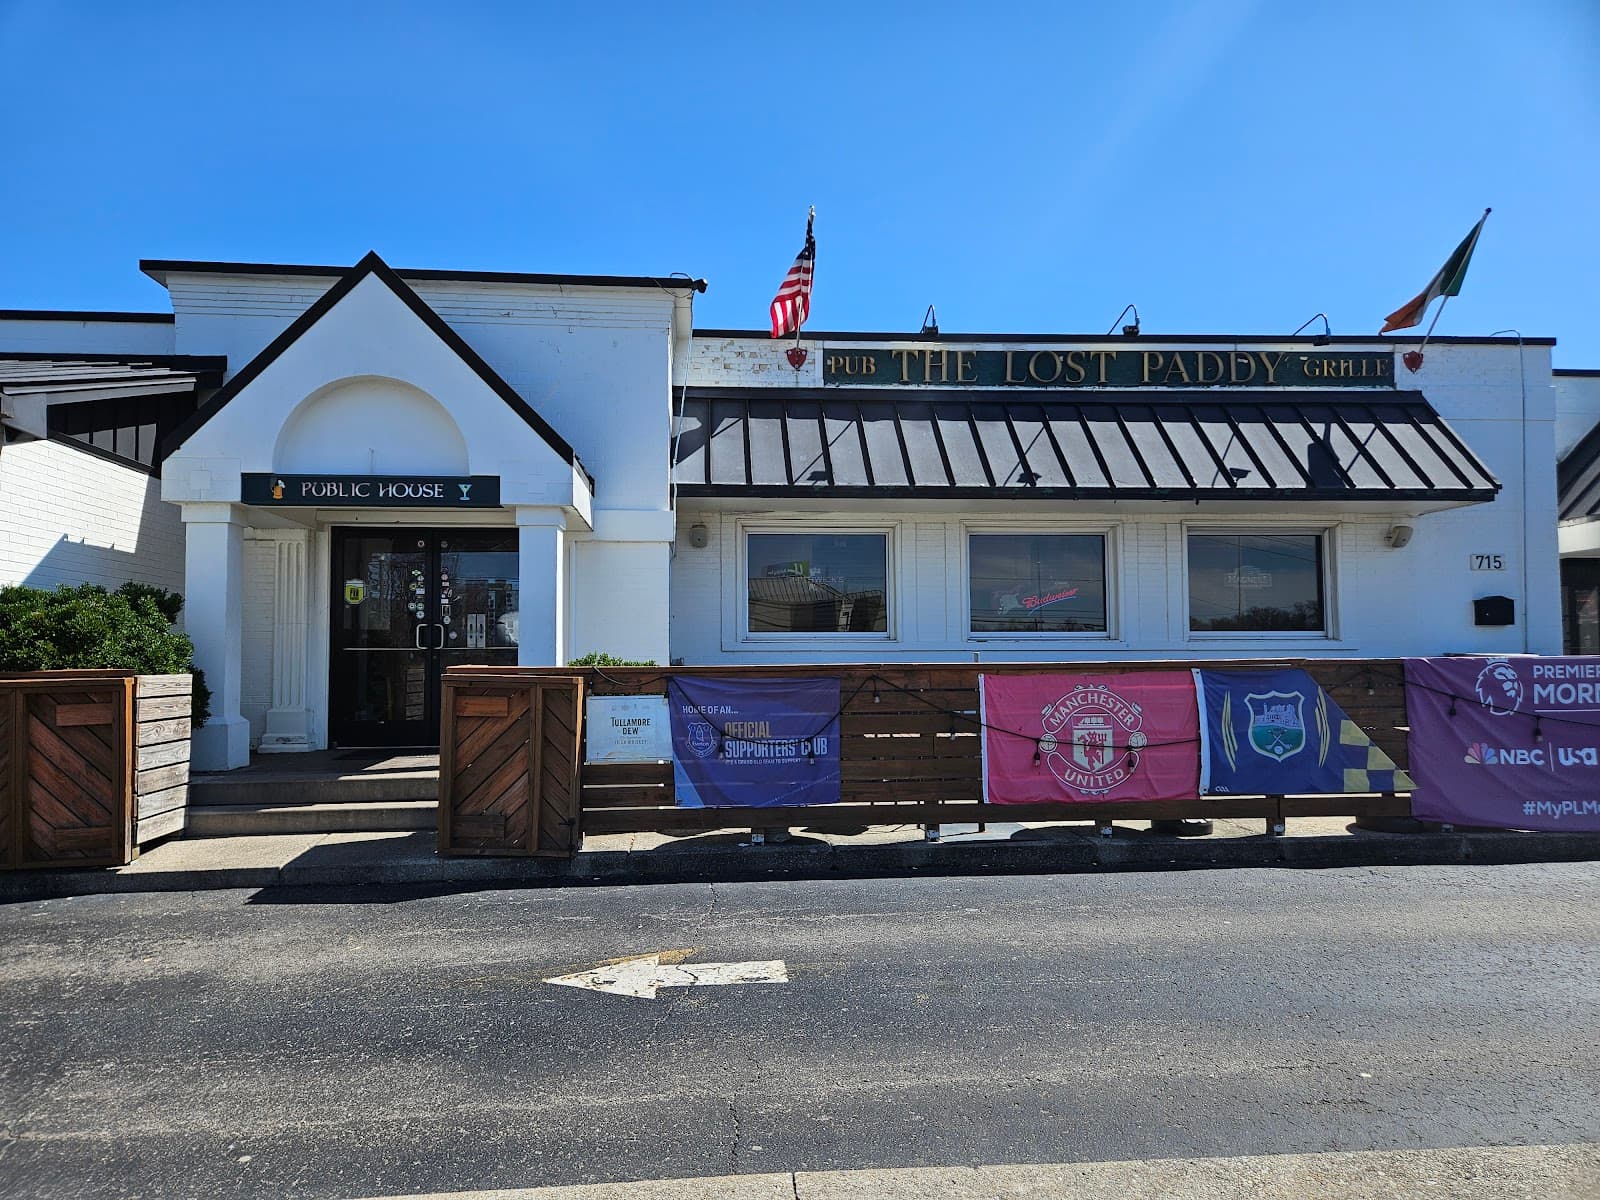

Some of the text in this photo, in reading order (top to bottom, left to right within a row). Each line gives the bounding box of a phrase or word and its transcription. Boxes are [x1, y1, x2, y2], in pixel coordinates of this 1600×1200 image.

[829, 356, 876, 375] PUB
[892, 350, 1287, 384] THE LOST PADDY
[1302, 358, 1389, 378] GRILLE
[301, 481, 445, 498] PUBLIC HOUSE
[1475, 555, 1502, 569] 715
[707, 705, 719, 714] OF
[1049, 692, 1134, 727] MANCHESTER
[622, 727, 639, 735] DEW
[725, 721, 772, 739] OFFICIAL
[801, 737, 828, 756] CUB
[1500, 749, 1545, 765] NBC
[1064, 768, 1124, 787] UNITED
